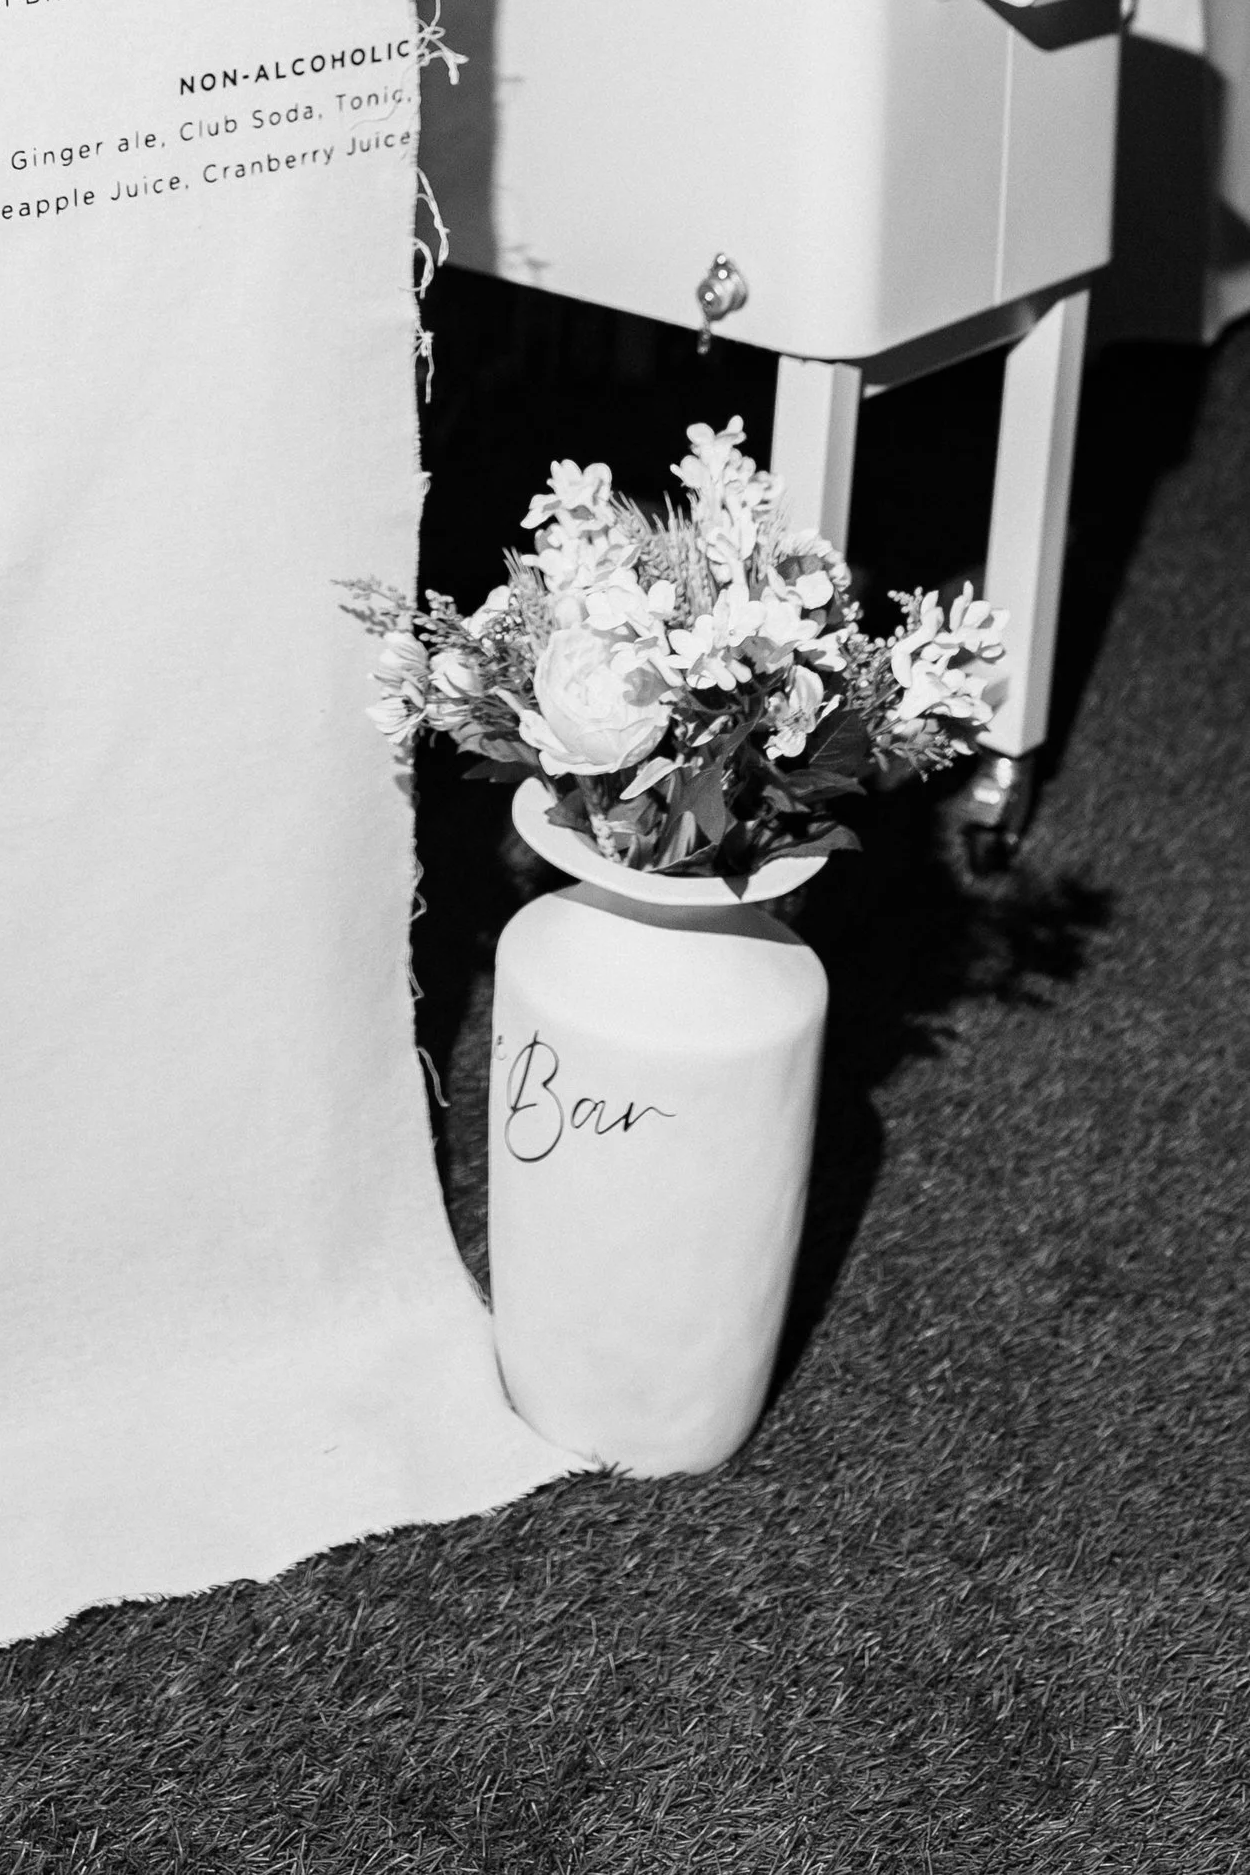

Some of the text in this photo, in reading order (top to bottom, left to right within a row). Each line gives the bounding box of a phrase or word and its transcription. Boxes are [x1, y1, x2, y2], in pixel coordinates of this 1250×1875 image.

[179, 39, 410, 96] NON-ALCOHOLIC
[10, 141, 103, 177] Ginger
[117, 131, 166, 153] ale,
[179, 115, 238, 142] Club
[251, 104, 323, 130] Soda,
[110, 175, 189, 202] Juice,
[202, 146, 334, 184] Cranberry
[346, 131, 411, 156] Juice
[504, 1029, 677, 1164] Bar
